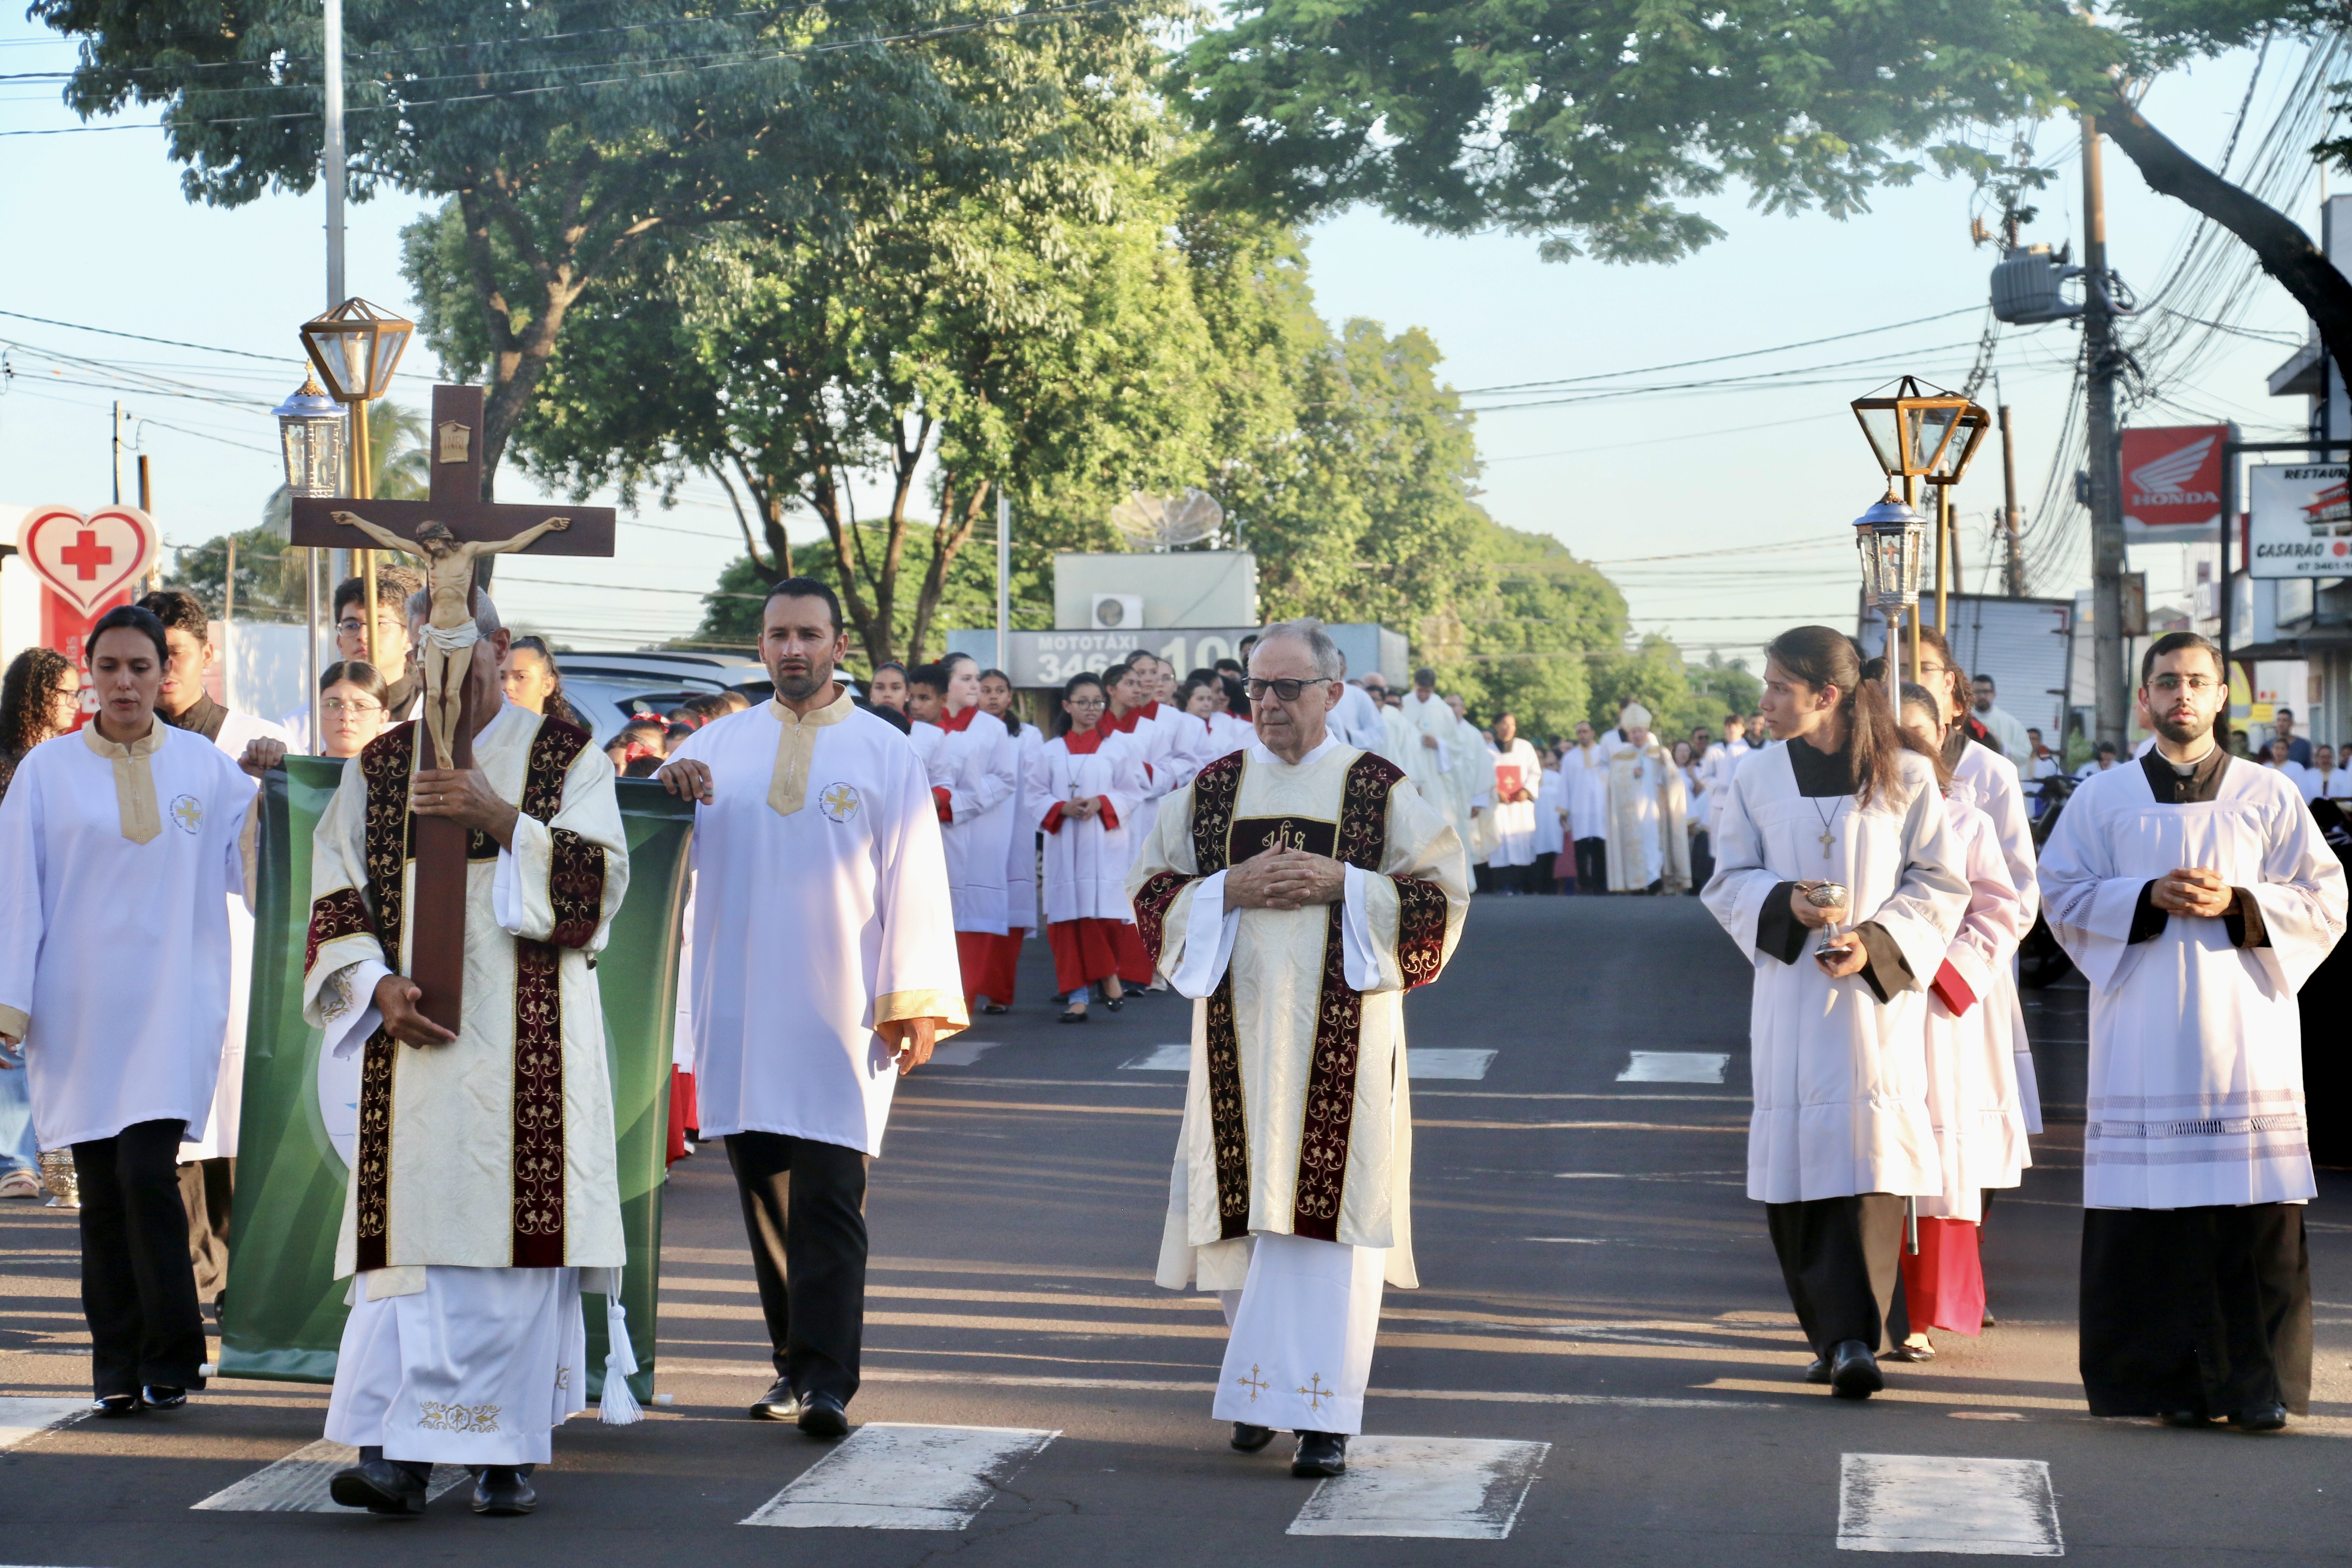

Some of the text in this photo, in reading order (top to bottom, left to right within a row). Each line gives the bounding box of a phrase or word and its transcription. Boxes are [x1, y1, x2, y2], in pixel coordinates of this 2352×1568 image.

[444, 435, 464, 450] INRI
[2284, 468, 2349, 480] RESTAUR
[2133, 491, 2220, 506] HONDA
[1038, 632, 1138, 651] MOTOTÁXI
